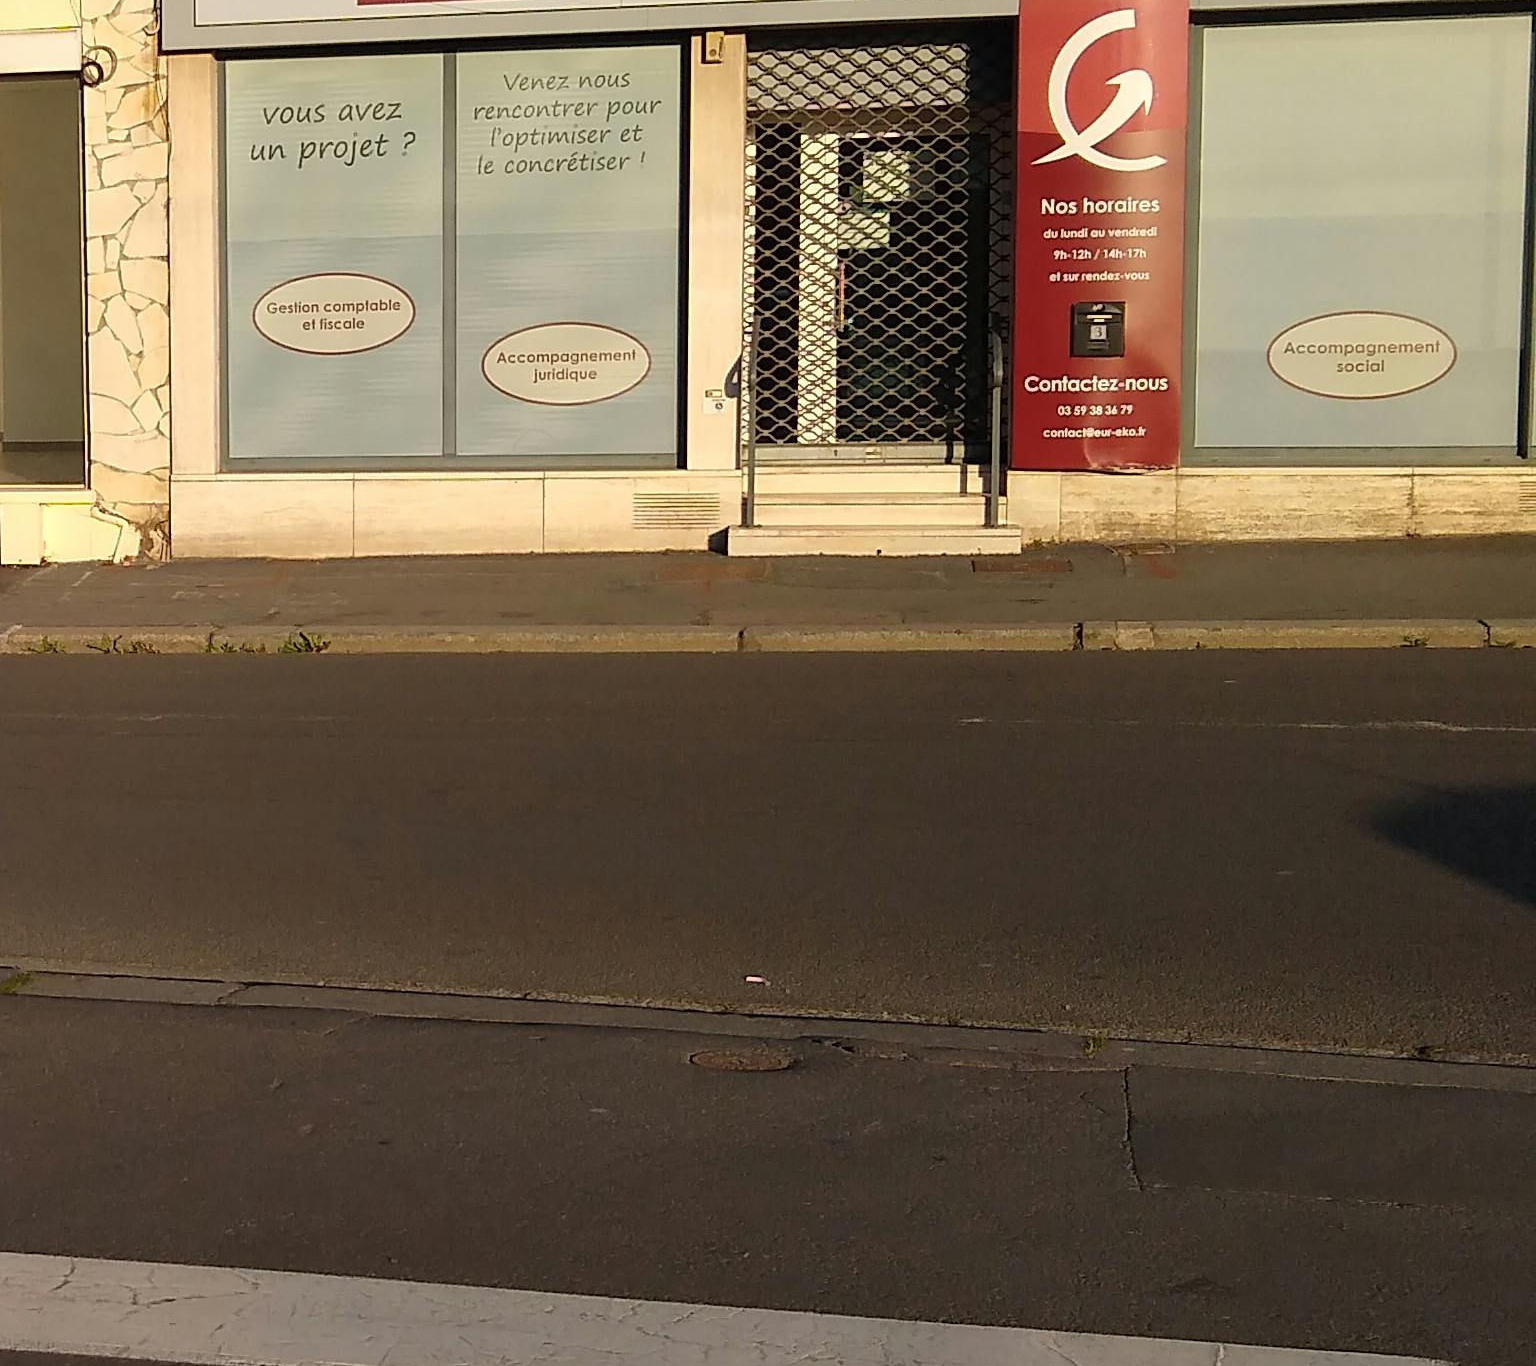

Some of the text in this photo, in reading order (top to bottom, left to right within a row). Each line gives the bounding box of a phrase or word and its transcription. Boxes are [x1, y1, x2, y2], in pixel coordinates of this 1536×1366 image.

[503, 72, 631, 91] Venez nous
[262, 100, 403, 125] vous avez
[473, 99, 663, 123] rencontrer pour
[620, 123, 643, 143] et
[250, 131, 416, 170] un projet ?
[477, 149, 647, 176] le concrétiser !
[1041, 196, 1161, 216] Nos horaires
[1043, 226, 1157, 240] du lundi au vendredi
[1053, 248, 1093, 261] 9h-12h
[1103, 247, 1147, 260] 14h-17h
[1049, 270, 1150, 283] et sur rendez-vous
[266, 298, 402, 317] Gestion comptable
[302, 316, 366, 331] et fiscale
[496, 348, 637, 366] Accompagnement
[1283, 339, 1441, 358] Accompagnement
[1336, 359, 1386, 373] social
[532, 367, 598, 384] juridique
[1024, 375, 1169, 393] Contactez-nous
[1057, 405, 1072, 417] 03
